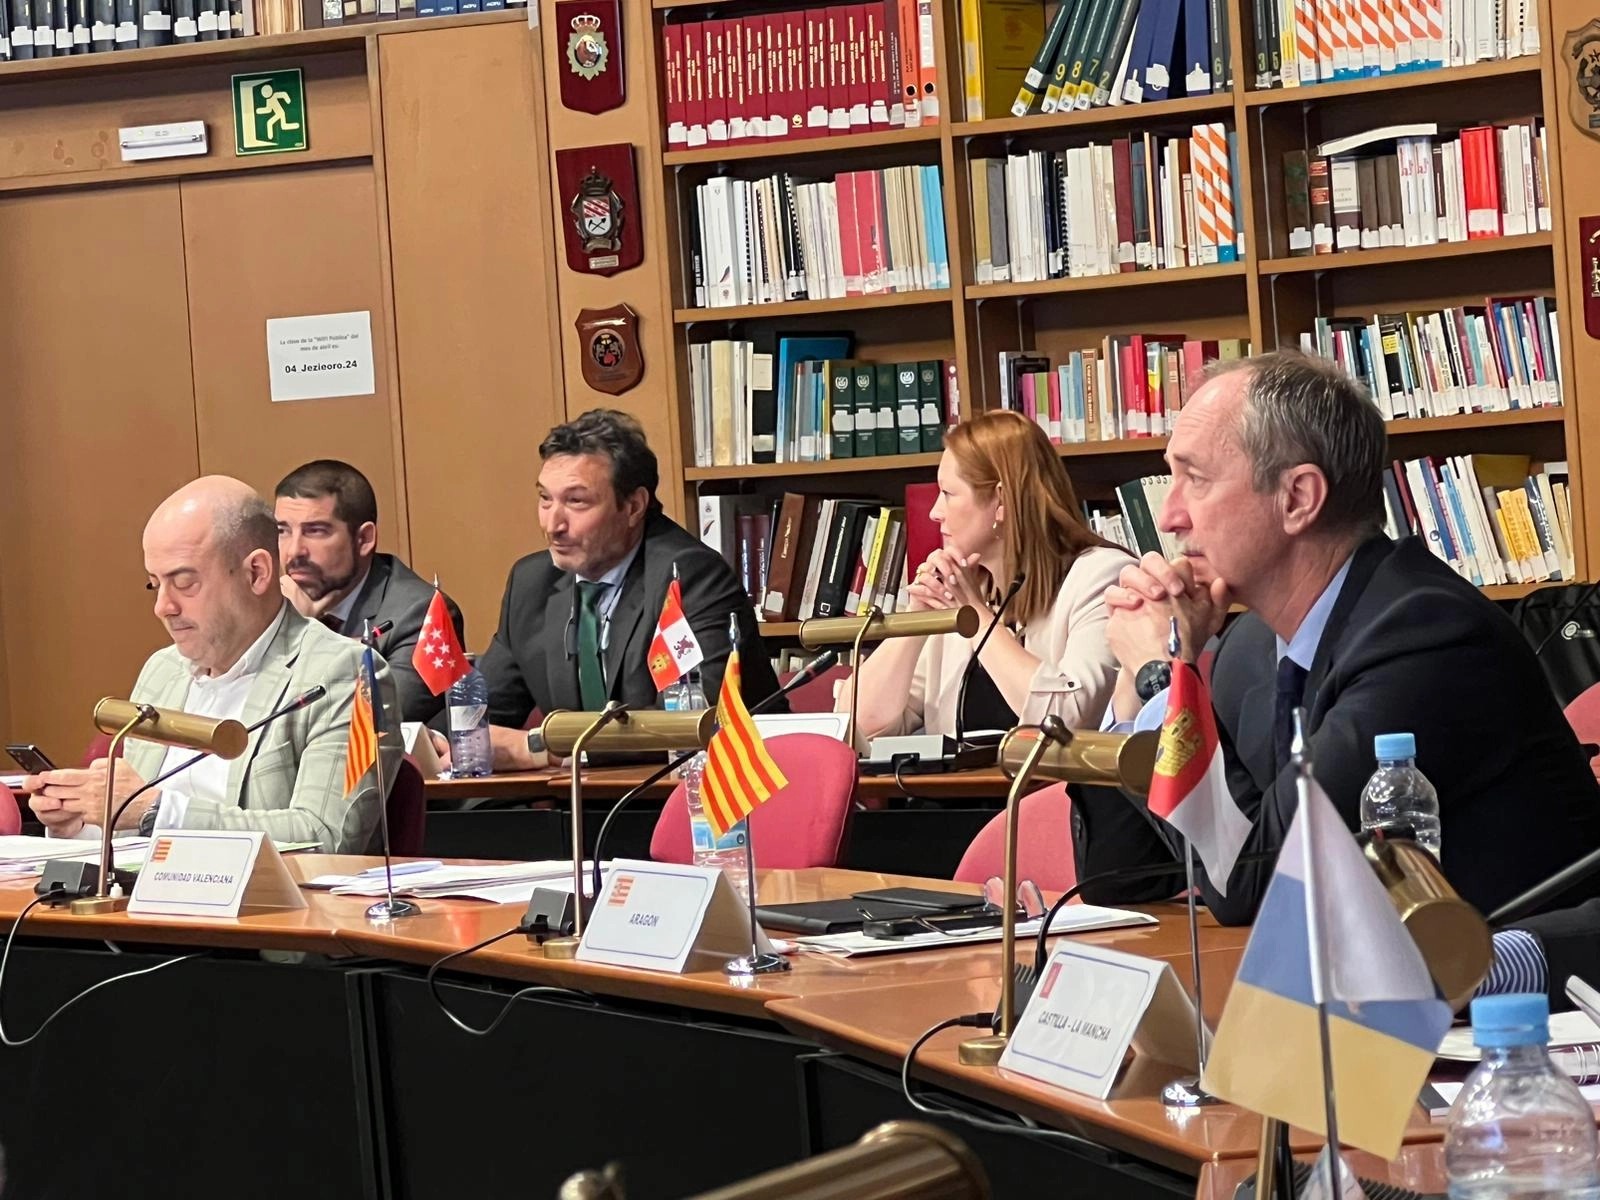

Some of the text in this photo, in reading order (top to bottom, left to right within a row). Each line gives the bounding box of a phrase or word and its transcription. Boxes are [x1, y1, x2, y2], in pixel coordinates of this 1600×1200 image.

[1072, 60, 1082, 78] 8
[1090, 59, 1099, 76] 7
[1214, 57, 1222, 75] 6
[1258, 52, 1266, 71] 3
[1056, 63, 1066, 81] 9
[1099, 71, 1110, 89] 2
[154, 872, 234, 884] COMUNIDAD VALENCIANA
[629, 913, 660, 927] ARAGON
[1038, 1010, 1068, 1030] CASTILLA
[1071, 1019, 1081, 1033] LA
[1081, 1020, 1112, 1041] MANCHA
